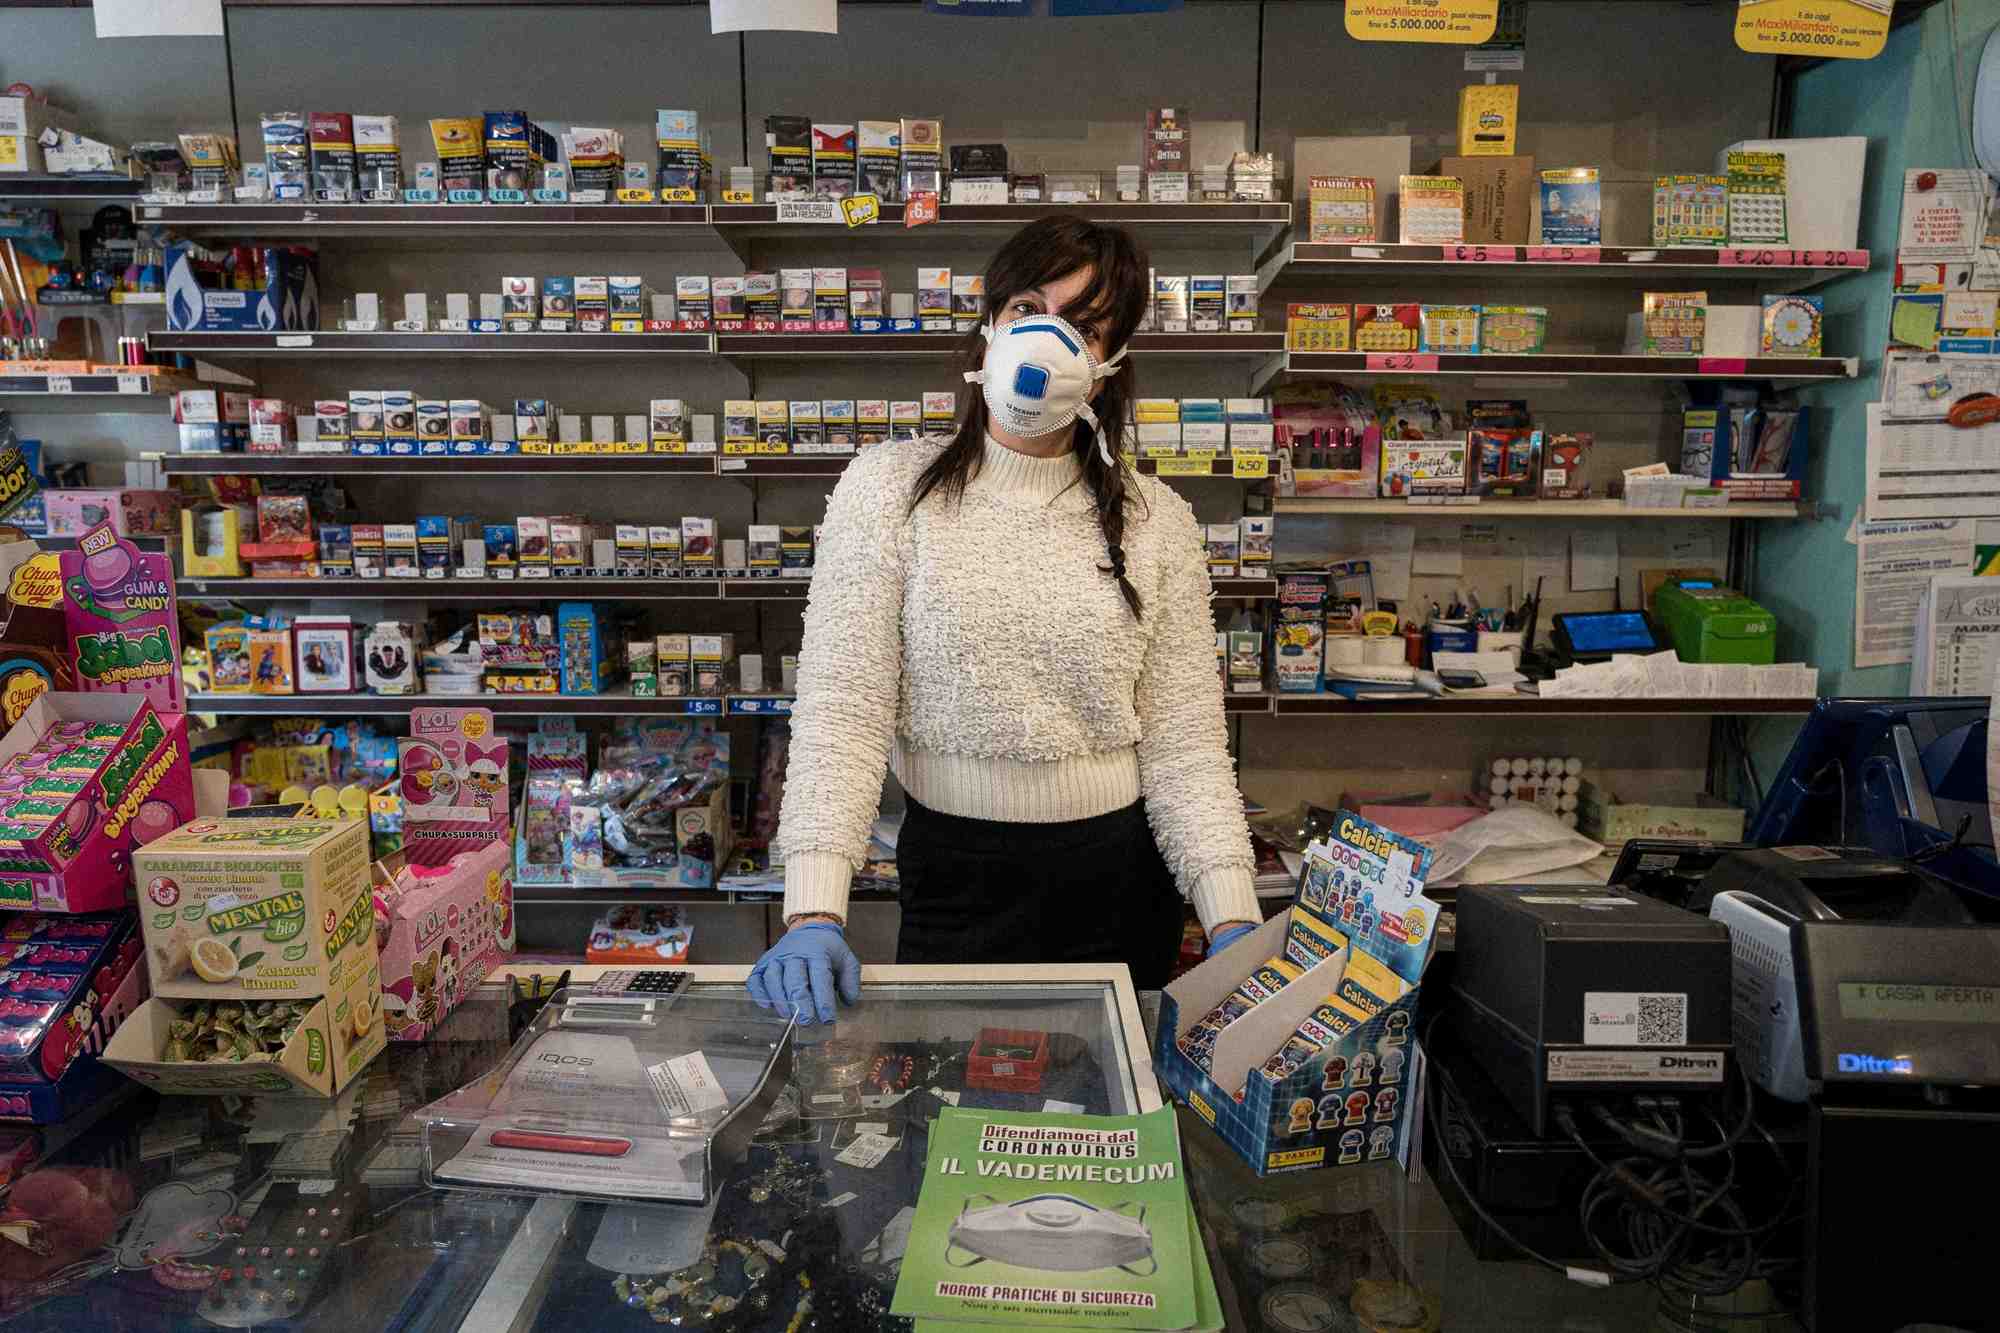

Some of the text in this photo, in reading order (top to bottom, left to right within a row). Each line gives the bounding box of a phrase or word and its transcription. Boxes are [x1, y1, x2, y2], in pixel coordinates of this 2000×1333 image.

[1390, 18, 1446, 30] 5.000.000
[1779, 32, 1836, 45] 5.000.000
[1456, 246, 1487, 262] € 5
[1561, 247, 1574, 261] 5
[1735, 251, 1745, 262] €
[1802, 250, 1848, 265] € 20
[1384, 356, 1415, 369] € 2
[86, 530, 111, 552] NEW
[124, 581, 168, 595] GUM &
[126, 596, 170, 611] CANDY
[695, 702, 716, 712] 5.00
[144, 861, 304, 873] CARAMELLE BIOLOGICHE
[275, 919, 297, 936] bio
[1875, 986, 1925, 1000] CASSA
[1659, 1056, 1718, 1069] Ditron
[984, 1124, 1135, 1144] Difendiamoci dal
[982, 1139, 1136, 1159] CORONAVIRUS
[940, 1157, 1176, 1185] IL VADEMECUM
[939, 1283, 1155, 1307] NORME PRATICHE DI SICUREZZA
